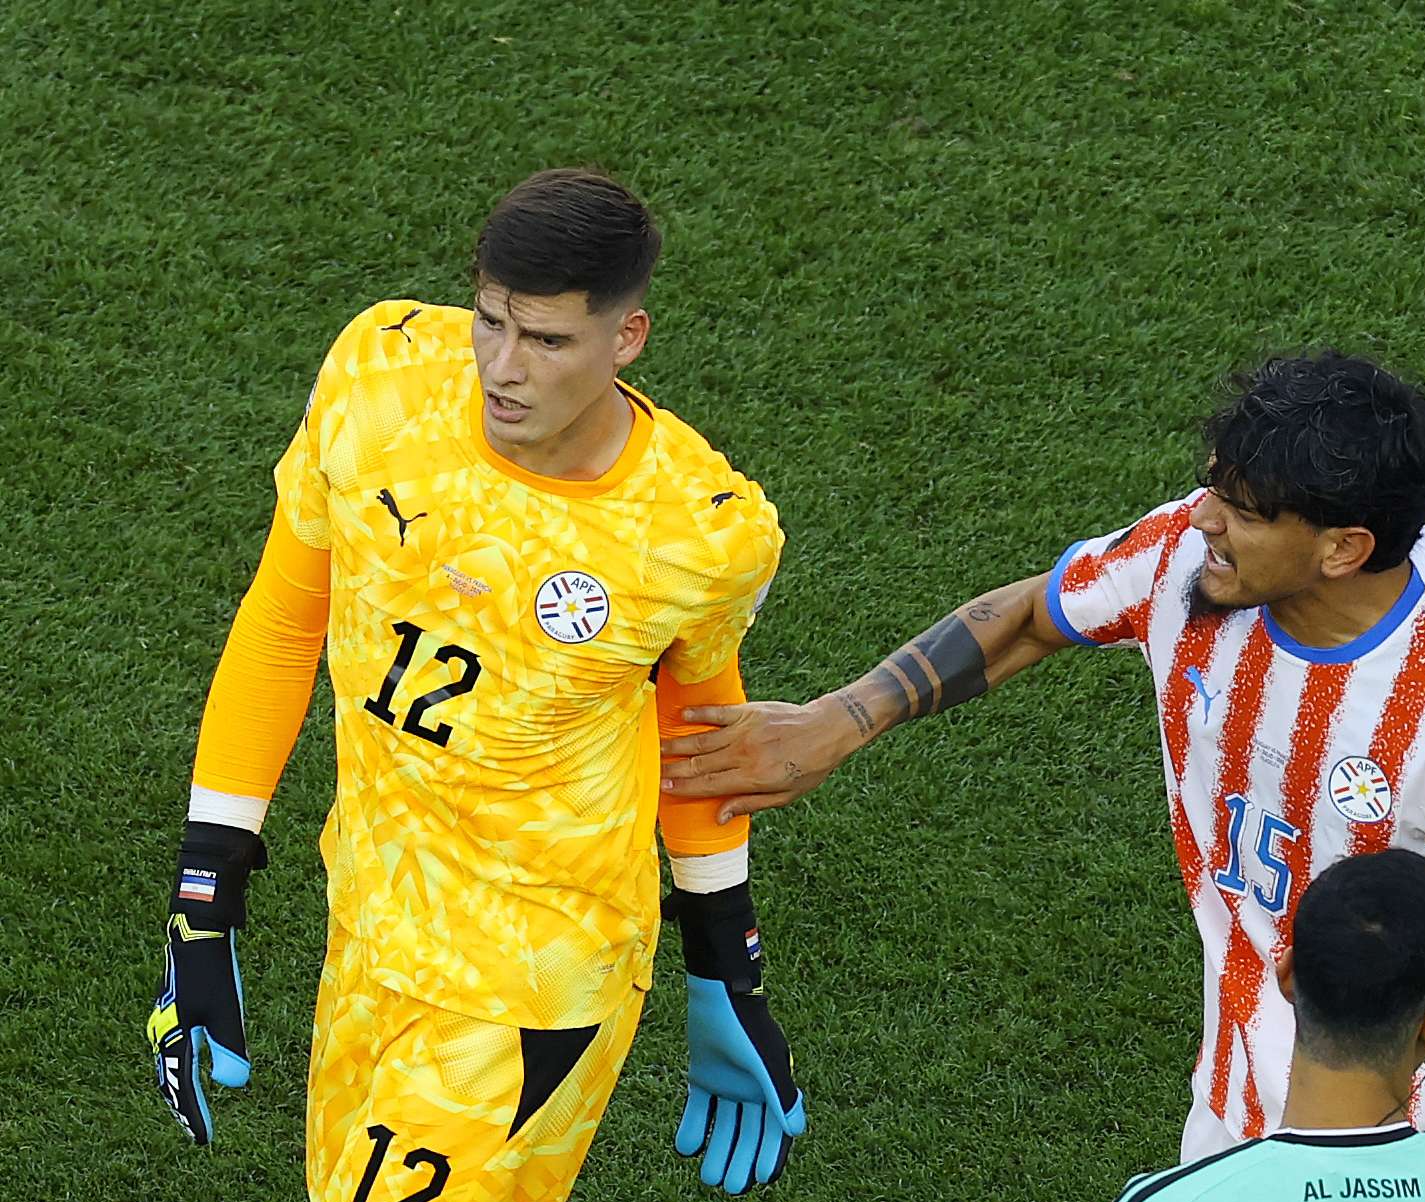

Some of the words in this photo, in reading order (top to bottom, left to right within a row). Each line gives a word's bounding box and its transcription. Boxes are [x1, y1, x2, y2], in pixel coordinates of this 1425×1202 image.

[570, 577, 596, 594] APF
[363, 621, 481, 748] 12
[1356, 761, 1377, 775] APF
[1214, 793, 1302, 918] 15
[1304, 1179, 1332, 1202] AL
[1340, 1177, 1422, 1199] JASSIM
